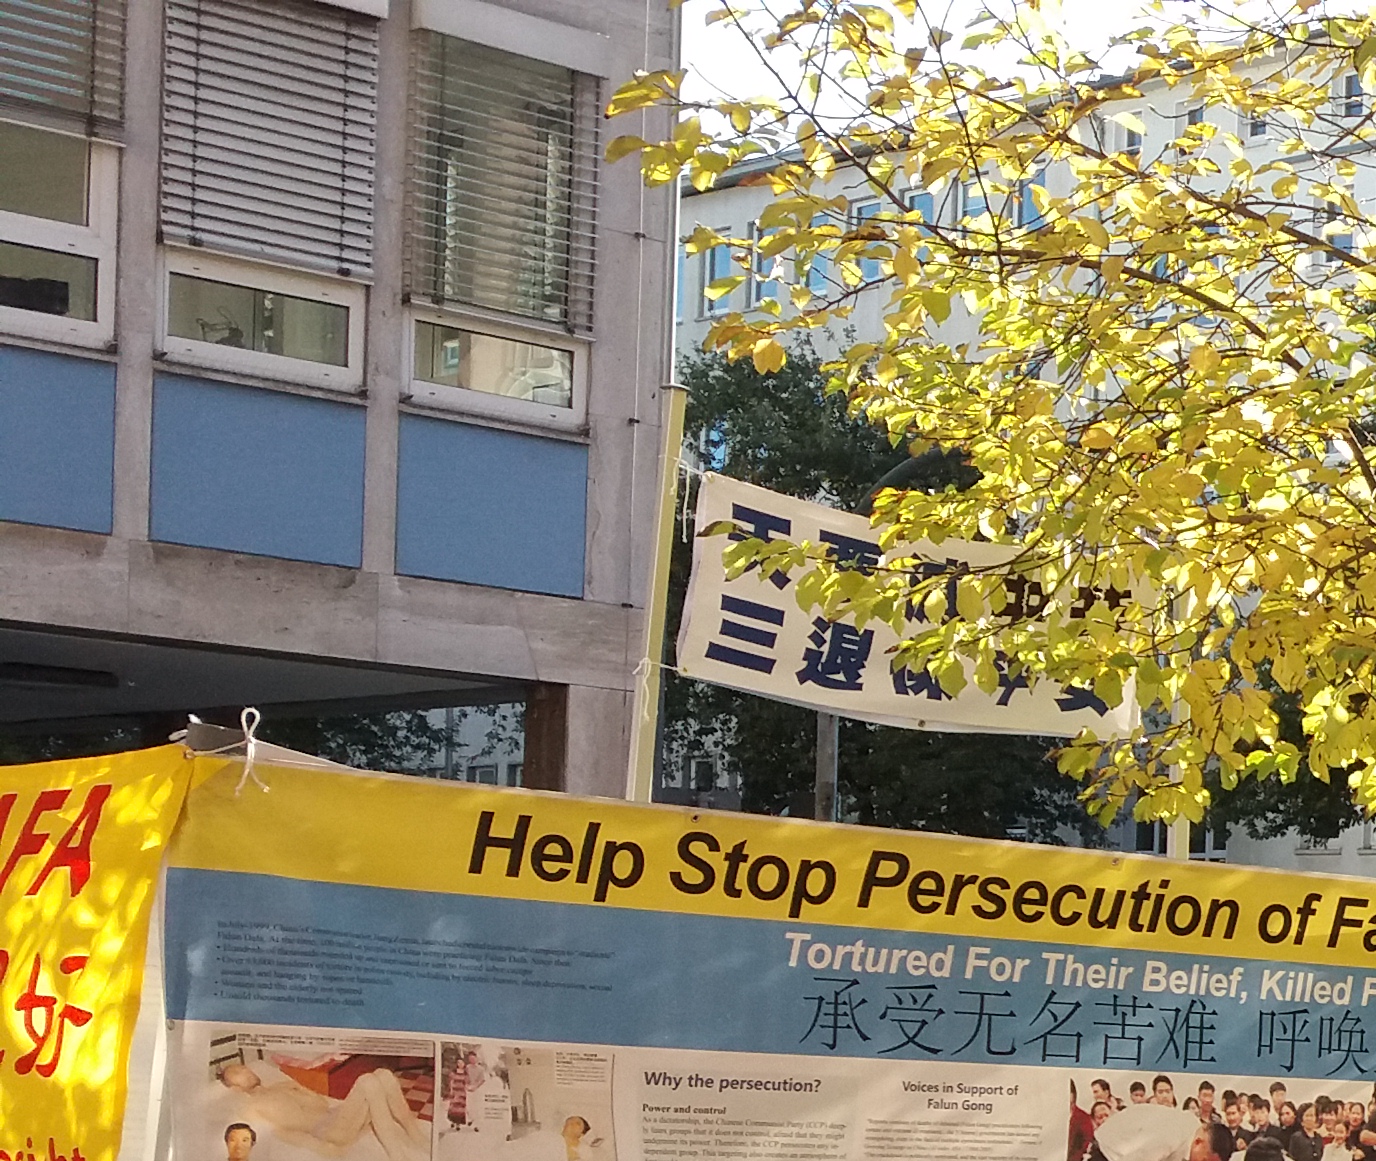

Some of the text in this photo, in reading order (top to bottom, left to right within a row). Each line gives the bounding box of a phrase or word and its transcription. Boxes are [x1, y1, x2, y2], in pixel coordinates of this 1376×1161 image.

[0, 784, 112, 897] FA
[468, 811, 646, 902] Help
[669, 832, 836, 918] Stop
[857, 850, 1235, 940] Persecution
[1258, 893, 1323, 946] of
[785, 932, 952, 980] Tortured
[966, 947, 1031, 985] For
[1041, 953, 1131, 990] Their
[1143, 959, 1248, 1004] Belief,
[1259, 970, 1353, 1007] Killed
[799, 977, 1218, 1070] 承受无名苦难
[644, 1071, 822, 1093] Why the persecution?
[902, 1081, 1018, 1097] Voices in Support of
[927, 1098, 993, 1113] Falun Gong
[642, 1103, 727, 1115] Power and control
